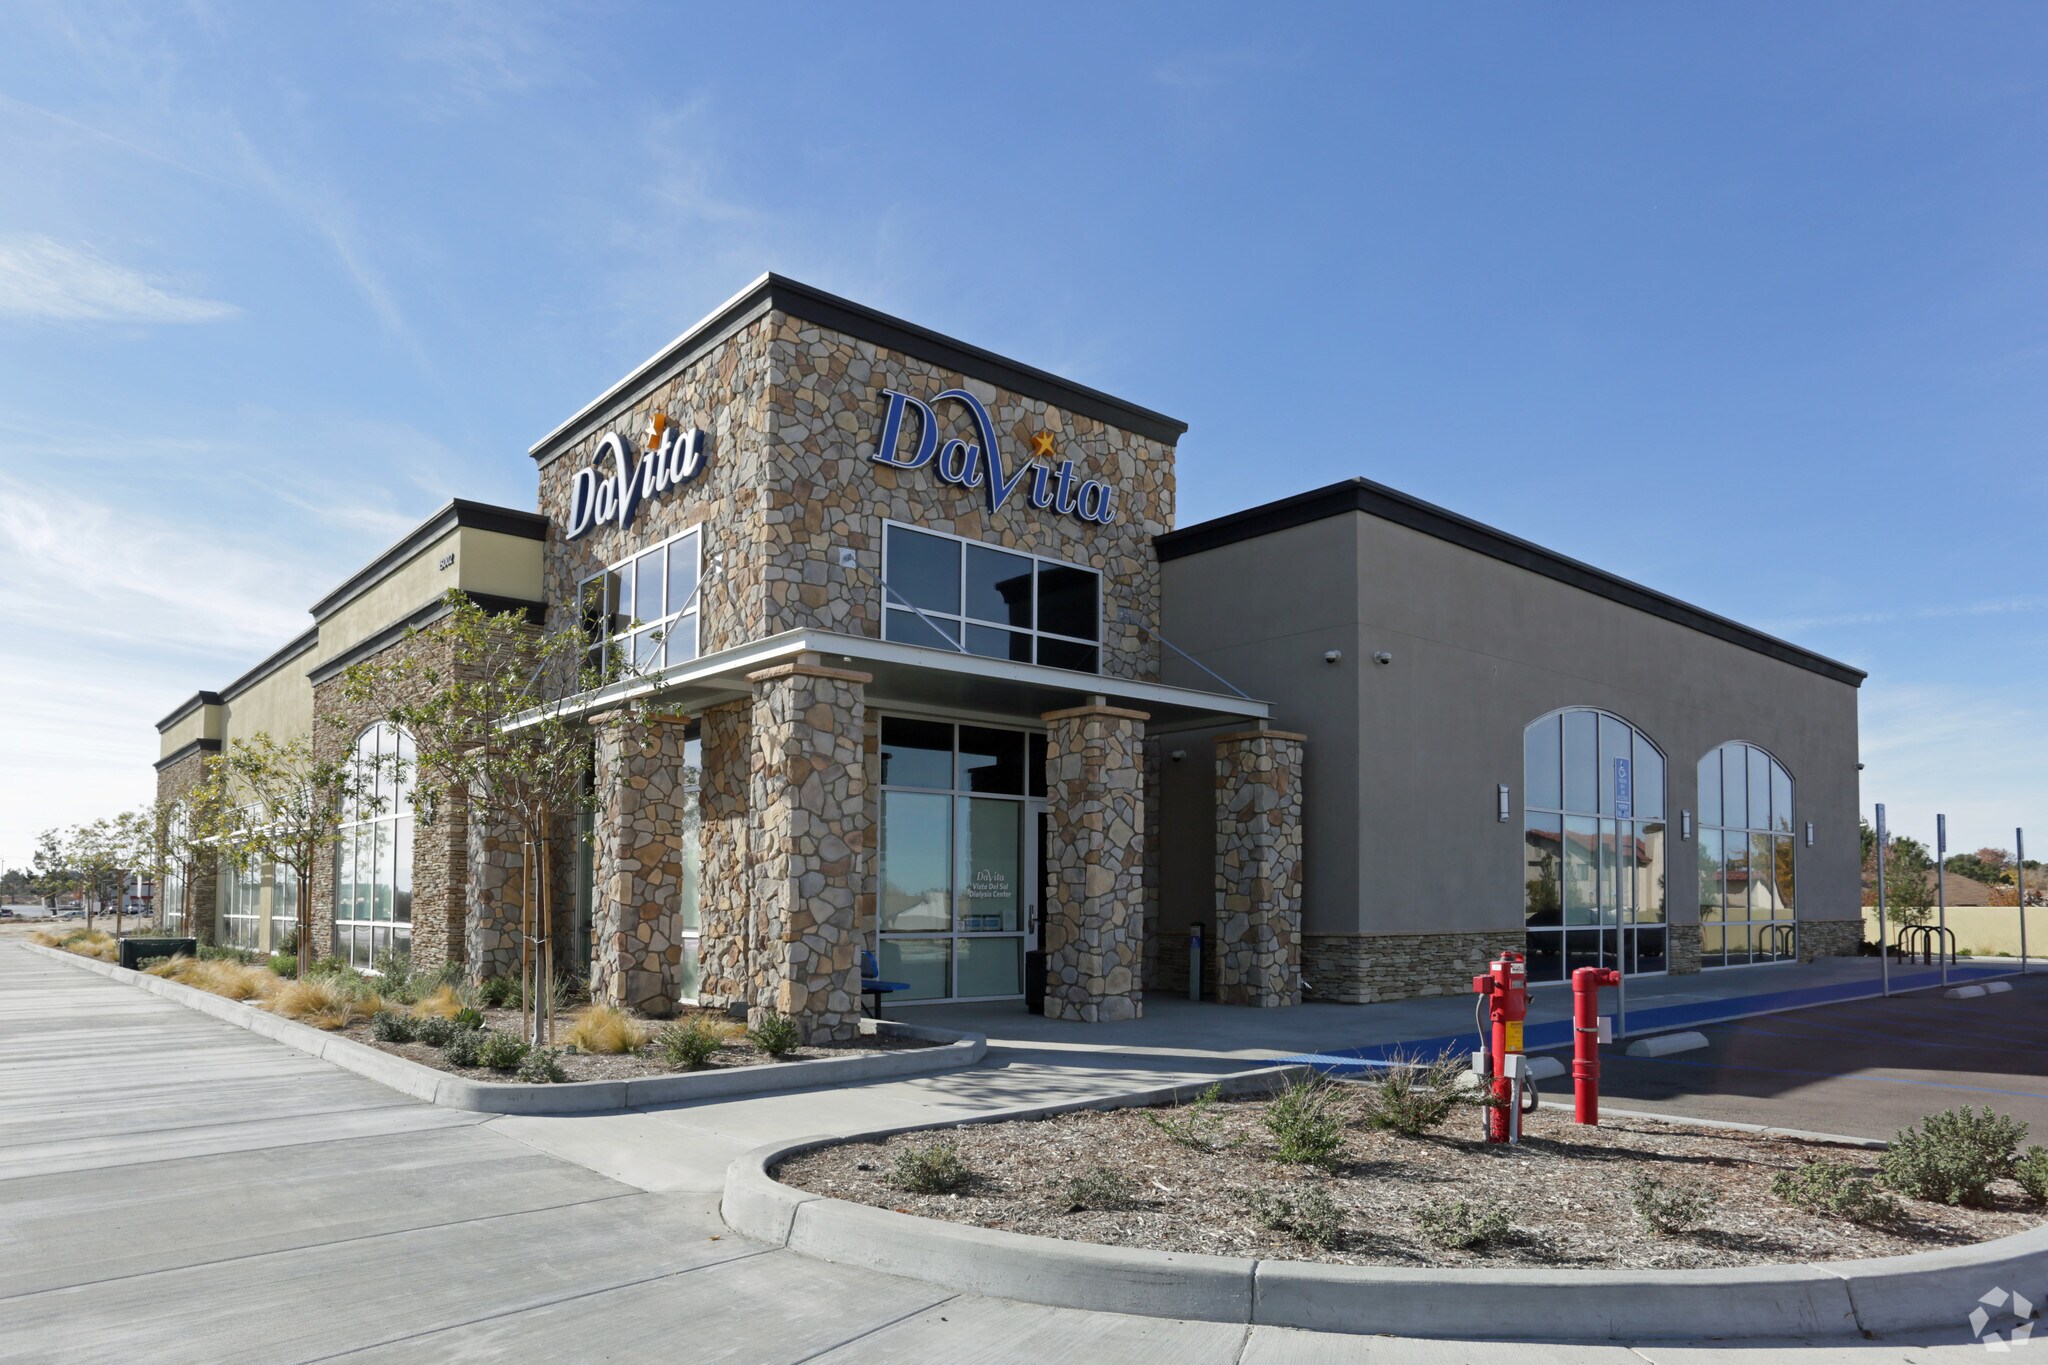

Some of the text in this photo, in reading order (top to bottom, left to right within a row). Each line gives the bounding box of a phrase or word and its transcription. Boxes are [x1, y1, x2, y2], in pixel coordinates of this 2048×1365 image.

[566, 413, 704, 540] DaVita
[872, 388, 1117, 525] DaVita
[969, 890, 1011, 899] Dialysis Center
